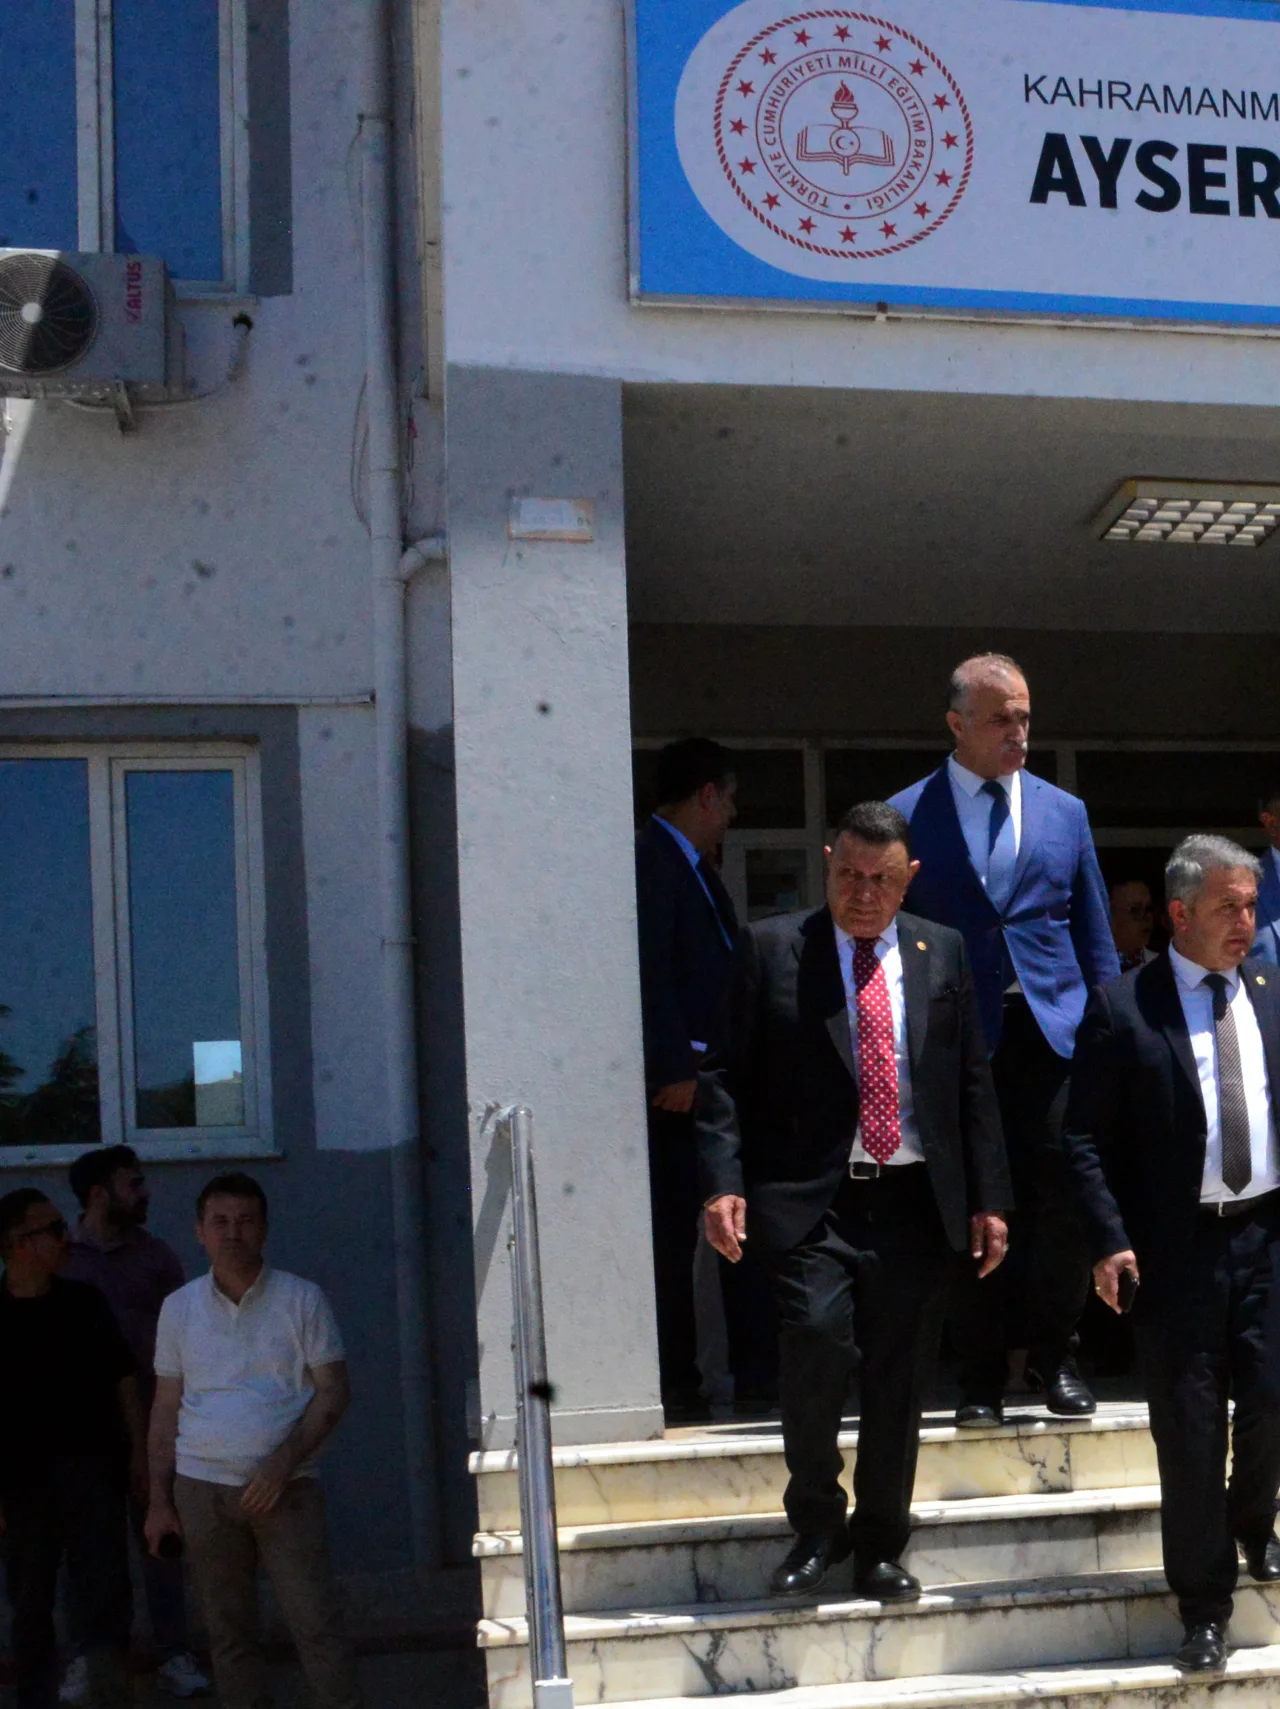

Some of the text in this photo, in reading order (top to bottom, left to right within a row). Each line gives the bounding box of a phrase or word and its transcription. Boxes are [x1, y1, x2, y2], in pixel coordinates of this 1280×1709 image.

[763, 54, 927, 211] TÜRKİYE CUMHURİYETİ MİLLİ EĞİTİM BAKANLIĞI
[127, 262, 142, 309] ALTUS
